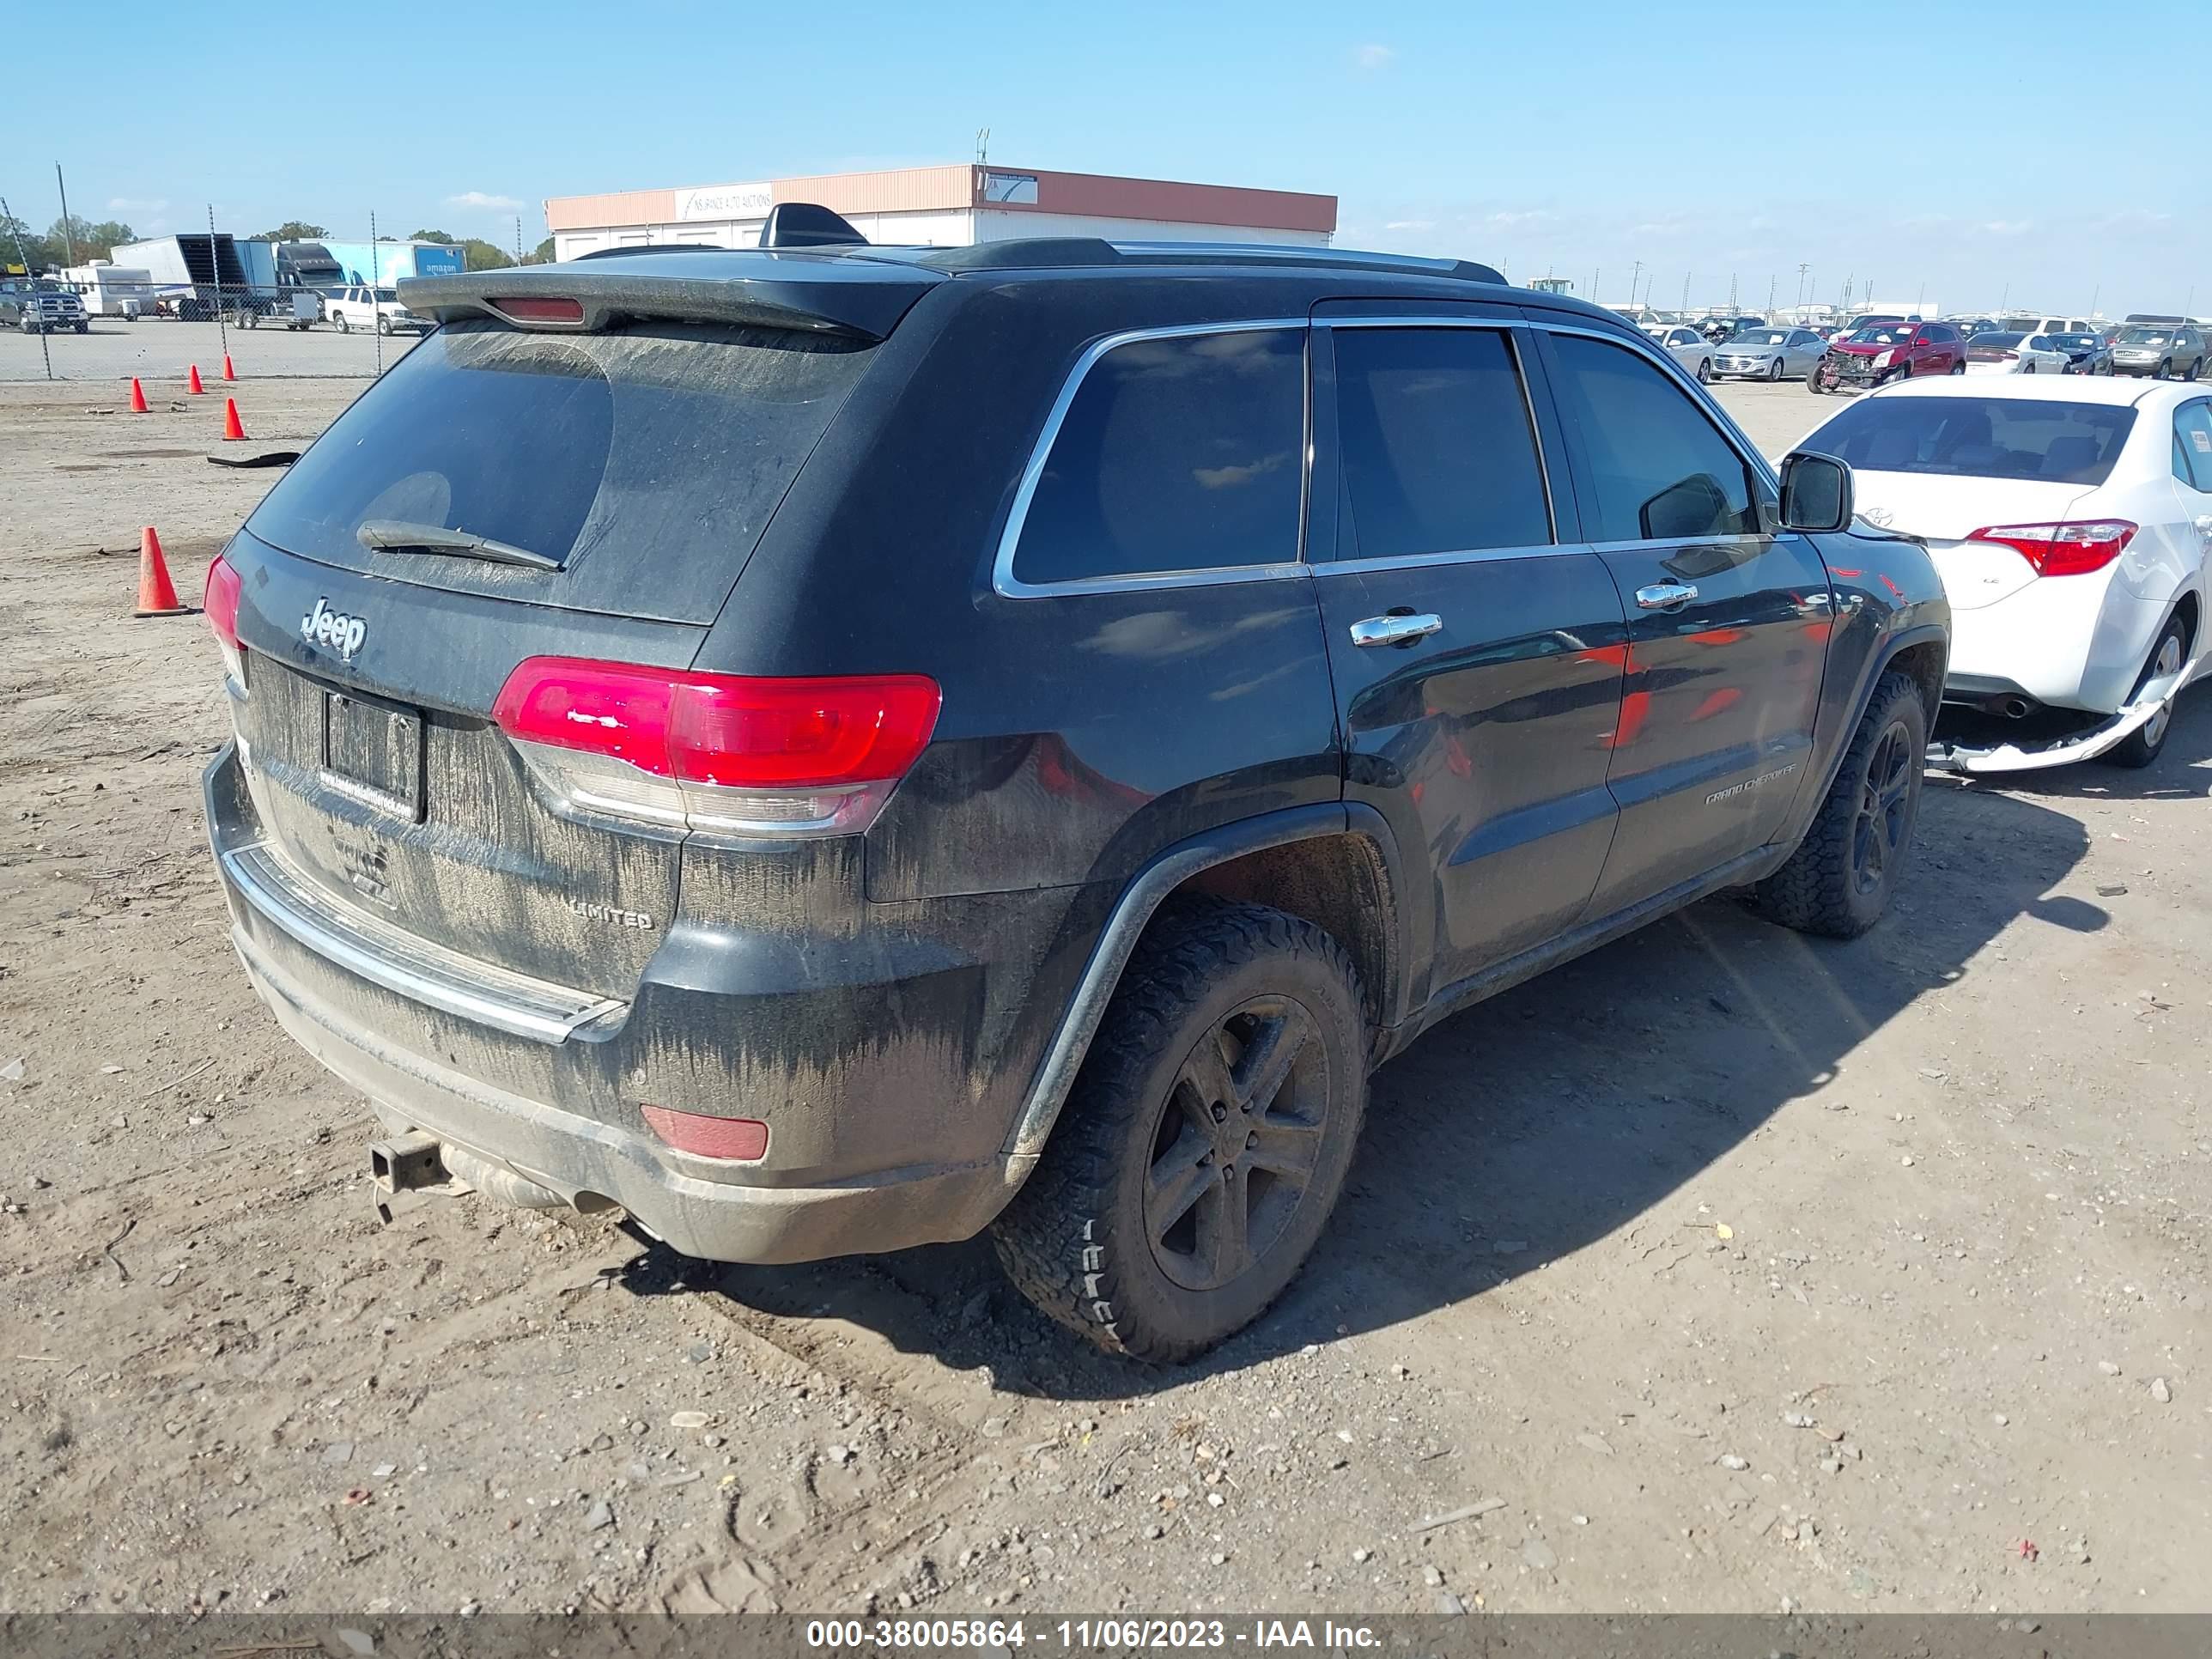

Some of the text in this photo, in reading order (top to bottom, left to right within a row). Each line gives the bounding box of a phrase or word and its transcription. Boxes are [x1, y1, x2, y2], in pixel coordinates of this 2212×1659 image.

[426, 264, 456, 273] amazon
[301, 596, 368, 662] Jeep
[1705, 763, 1796, 805] GRAND CHEROKEE
[568, 896, 655, 929] LIMITED
